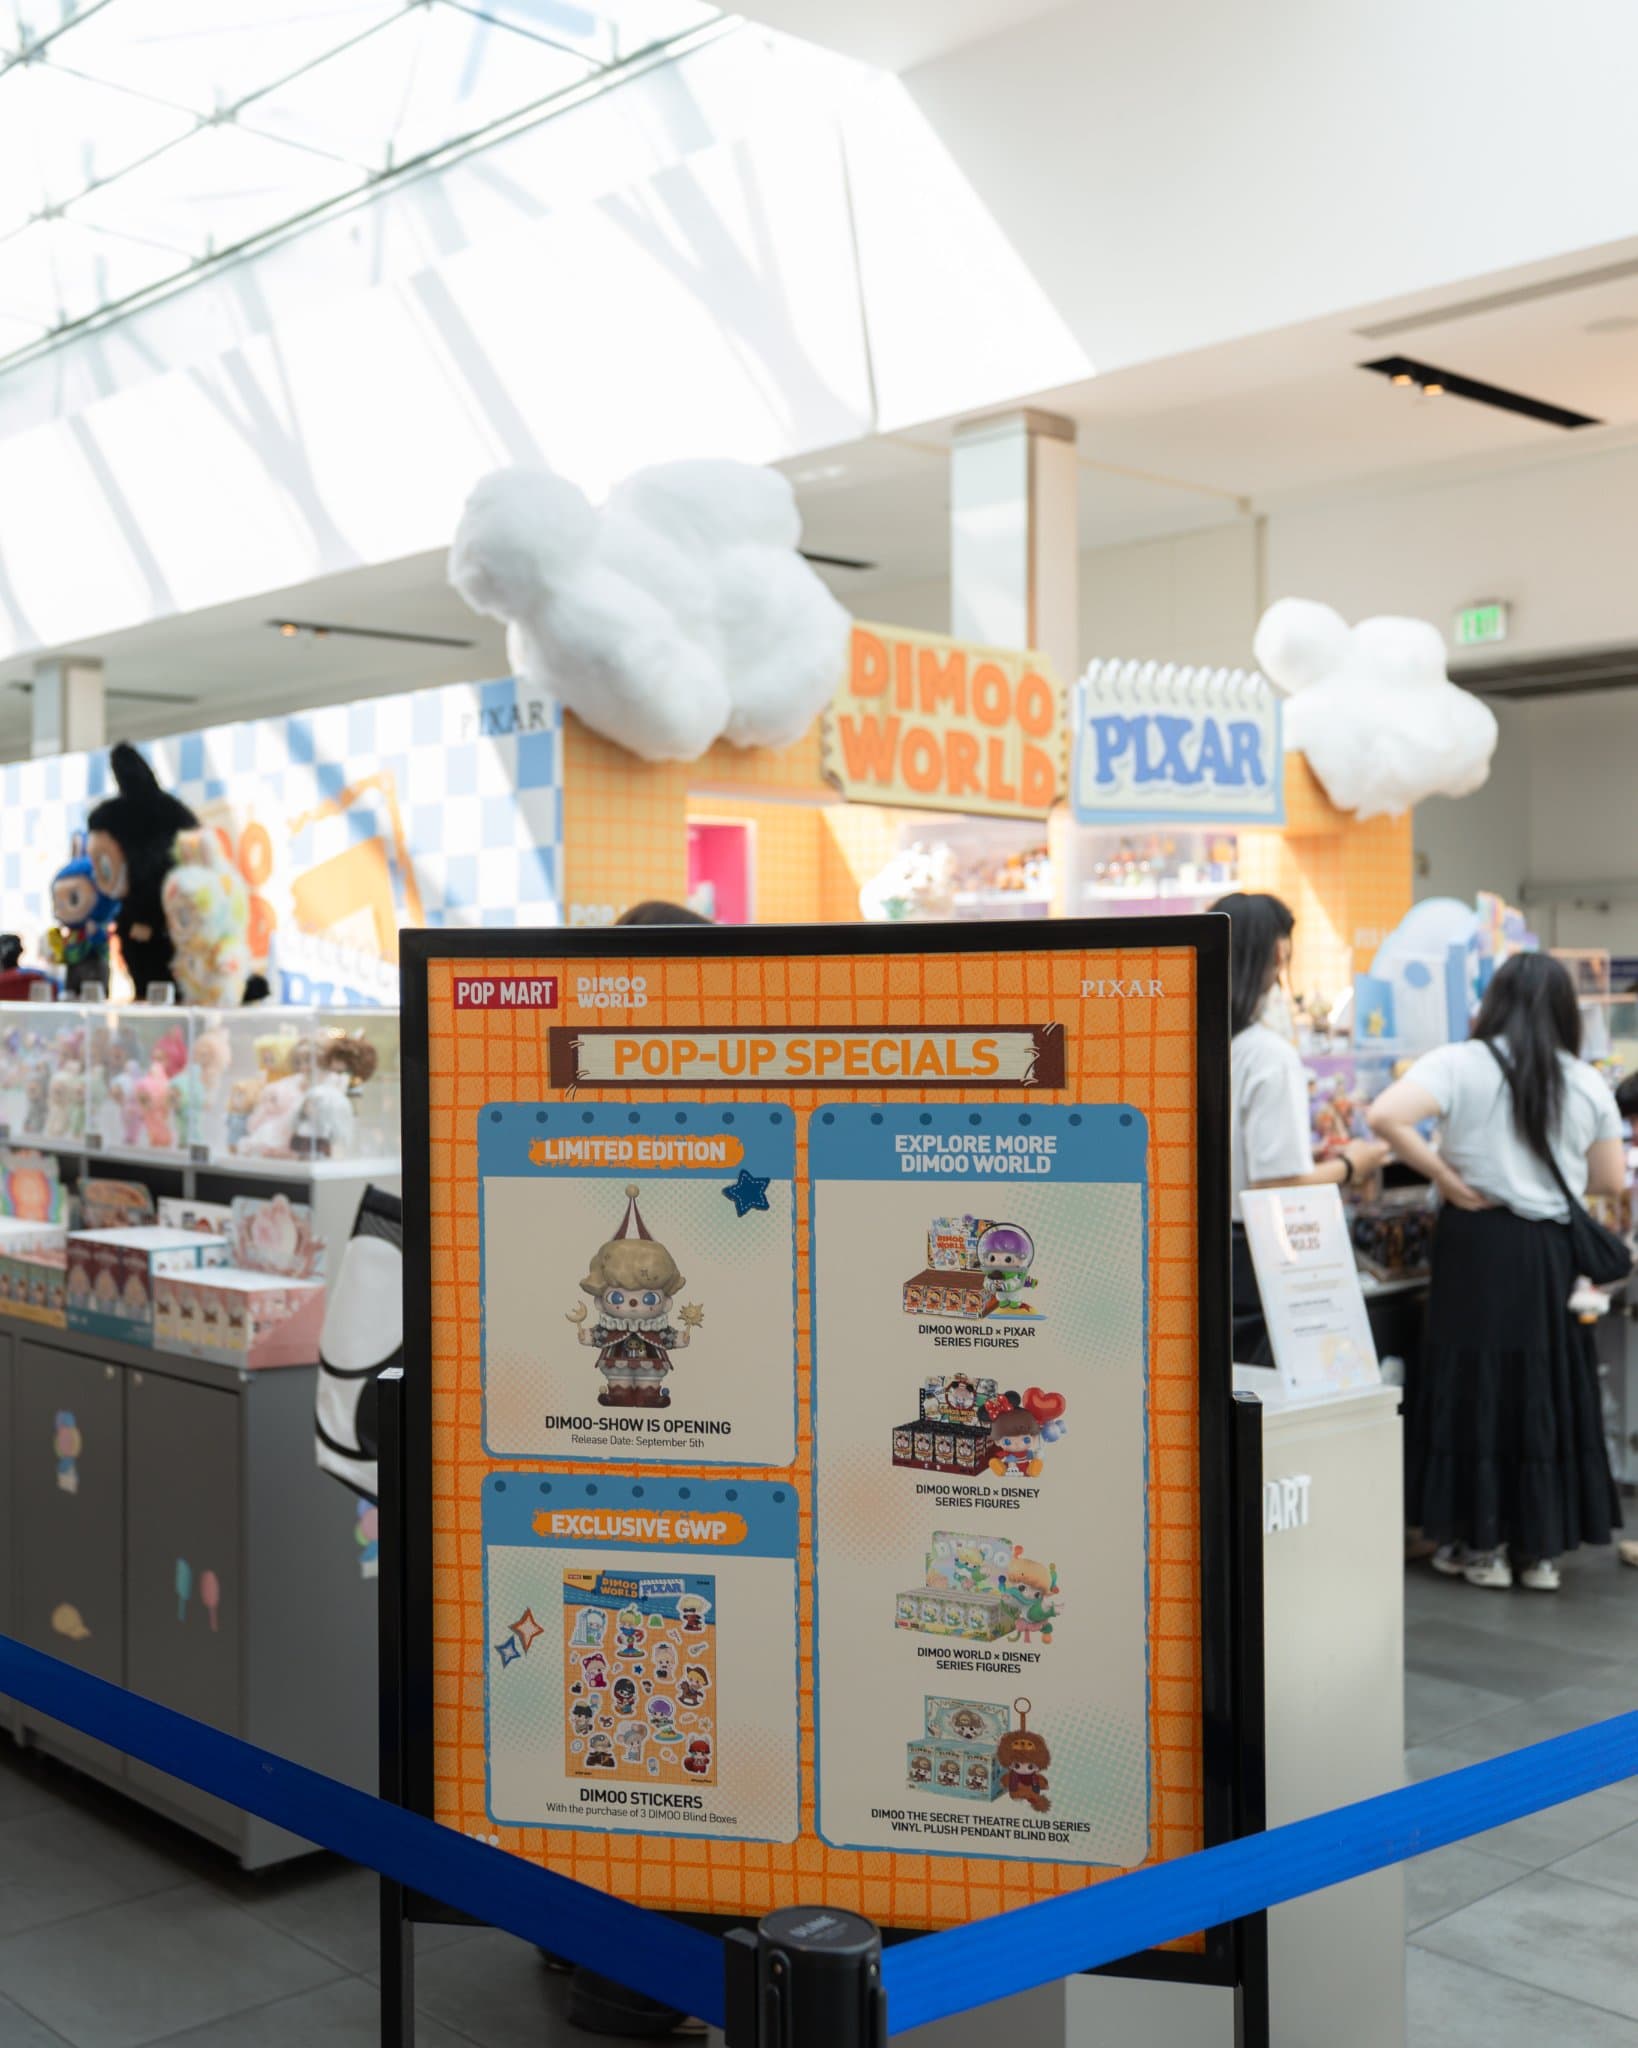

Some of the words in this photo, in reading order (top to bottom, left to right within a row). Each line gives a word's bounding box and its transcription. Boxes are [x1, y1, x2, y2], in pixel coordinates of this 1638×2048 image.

[850, 626, 1054, 738] DIMOO
[1090, 715, 1266, 786] PIXAR
[838, 713, 1056, 808] WORLD
[458, 981, 494, 1005] POP
[500, 981, 553, 1005] MART
[577, 976, 647, 993] DIMOO
[1080, 979, 1165, 998] PIXAR
[578, 992, 648, 1009] WORLD
[614, 1039, 776, 1076] POP-UP
[785, 1039, 999, 1076] SPECIALS
[545, 1140, 633, 1161] LIMITED
[638, 1141, 726, 1161] EDITION
[895, 1134, 991, 1153] EXPLORE
[995, 1135, 1057, 1154] MORE
[901, 1154, 969, 1173] DIMOO
[972, 1155, 1051, 1174] WORLD
[918, 1324, 952, 1335] DIMOO
[955, 1325, 993, 1336] WORLD
[1003, 1326, 1035, 1337] PIXAR
[934, 1337, 971, 1347] SERIES
[974, 1338, 1019, 1348] FIGURES
[545, 1415, 643, 1431] DIMOO-SHOW
[647, 1418, 660, 1432] IS
[664, 1420, 731, 1434] OPENING
[571, 1434, 608, 1446] Release
[610, 1435, 634, 1446] Date:
[636, 1436, 687, 1448] September
[689, 1437, 704, 1448] 5th
[916, 1484, 950, 1495] DIMOO
[952, 1485, 991, 1496] WORLD
[1001, 1487, 1040, 1498] DISNEY
[935, 1497, 973, 1508] SERIES
[975, 1498, 1020, 1509] FIGURES
[1263, 1475, 1312, 1534] ART
[552, 1514, 669, 1537] EXCLUSIVE
[674, 1519, 727, 1540] GWP
[601, 1586, 638, 1599] WORLD
[602, 1577, 638, 1590] DIMOO
[642, 1583, 682, 1595] PIXAR
[917, 1647, 951, 1658] DIMOO
[953, 1649, 991, 1660] WORLD
[1002, 1651, 1041, 1663] DISNEY
[936, 1660, 974, 1671] SERIES
[976, 1662, 1021, 1673] FIGURES
[580, 1788, 627, 1803] DIMOO
[630, 1792, 703, 1808] STICKERS
[546, 1802, 567, 1813] With
[569, 1803, 584, 1814] the
[586, 1805, 628, 1818] purchase
[630, 1808, 638, 1817] of
[640, 1808, 647, 1818] 3
[649, 1810, 681, 1821] DIMOO
[683, 1811, 707, 1823] Blind
[709, 1813, 738, 1825] Boxes
[871, 1808, 905, 1819] DIMOO
[907, 1811, 927, 1821] THE
[929, 1813, 971, 1825] SECRET
[973, 1815, 1020, 1828] THEATRE
[1022, 1819, 1050, 1830] CLUB
[1052, 1821, 1091, 1832] SERIES
[891, 1821, 922, 1833] VINYL
[923, 1824, 960, 1835] PLUSH
[960, 1826, 1012, 1839] PENDANT
[1013, 1830, 1046, 1842] BLIND
[1048, 1833, 1070, 1843] BOX
